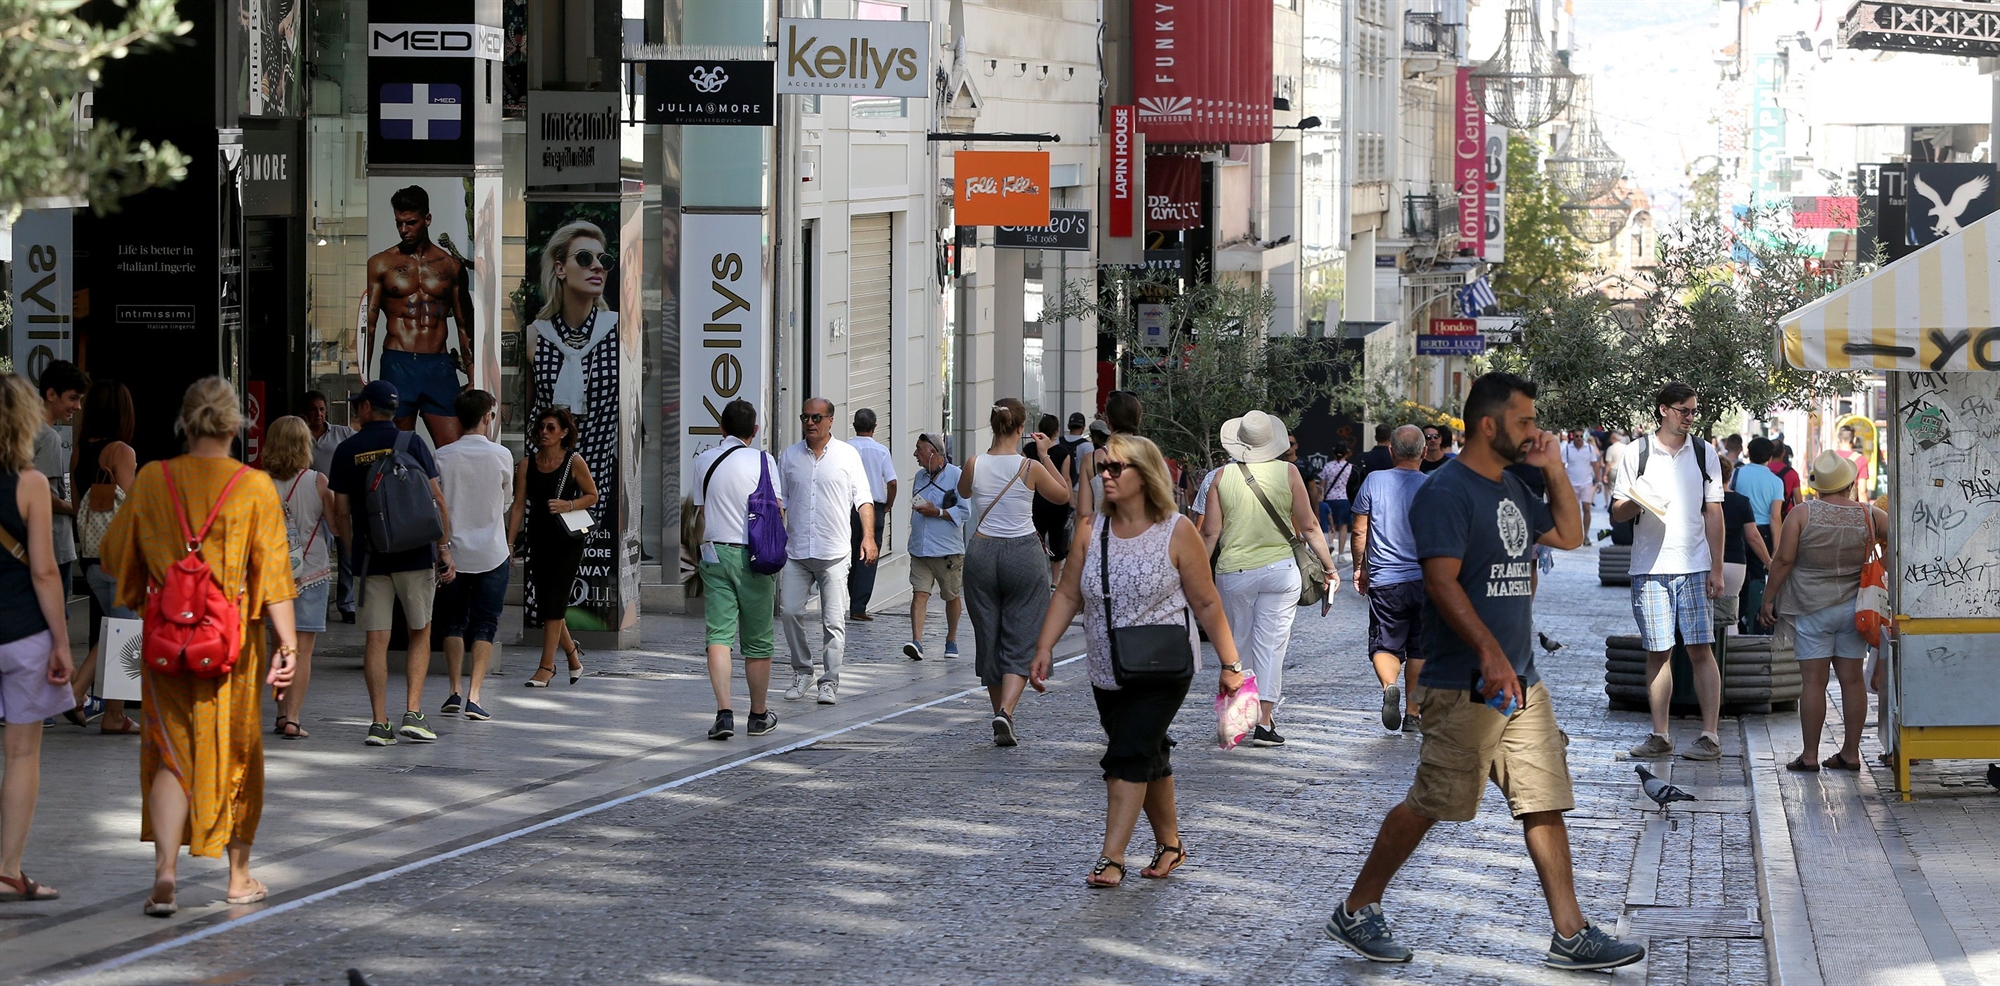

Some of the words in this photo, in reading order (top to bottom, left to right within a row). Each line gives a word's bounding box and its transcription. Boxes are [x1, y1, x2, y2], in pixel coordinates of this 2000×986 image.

[373, 30, 472, 51] MED
[479, 33, 500, 53] MED
[1155, 3, 1174, 83] FUNKY
[788, 25, 917, 89] kellys
[787, 81, 867, 89] ACCESSORIES
[657, 103, 703, 113] JULIA
[718, 103, 761, 114] MORE
[1115, 108, 1128, 156] HOUSE
[253, 153, 287, 181] MORE
[1115, 158, 1128, 198] LAPIN
[965, 176, 998, 201] Folli
[1026, 234, 1038, 243] Est
[1040, 234, 1058, 243] 1968
[118, 244, 138, 255] Life
[140, 244, 148, 255] is
[150, 244, 181, 255] better
[183, 244, 194, 255] in
[116, 261, 196, 274] #ItalianLingerie
[120, 310, 191, 318] intimissimi
[169, 323, 196, 331] lingerie
[1434, 321, 1474, 331] Hondos
